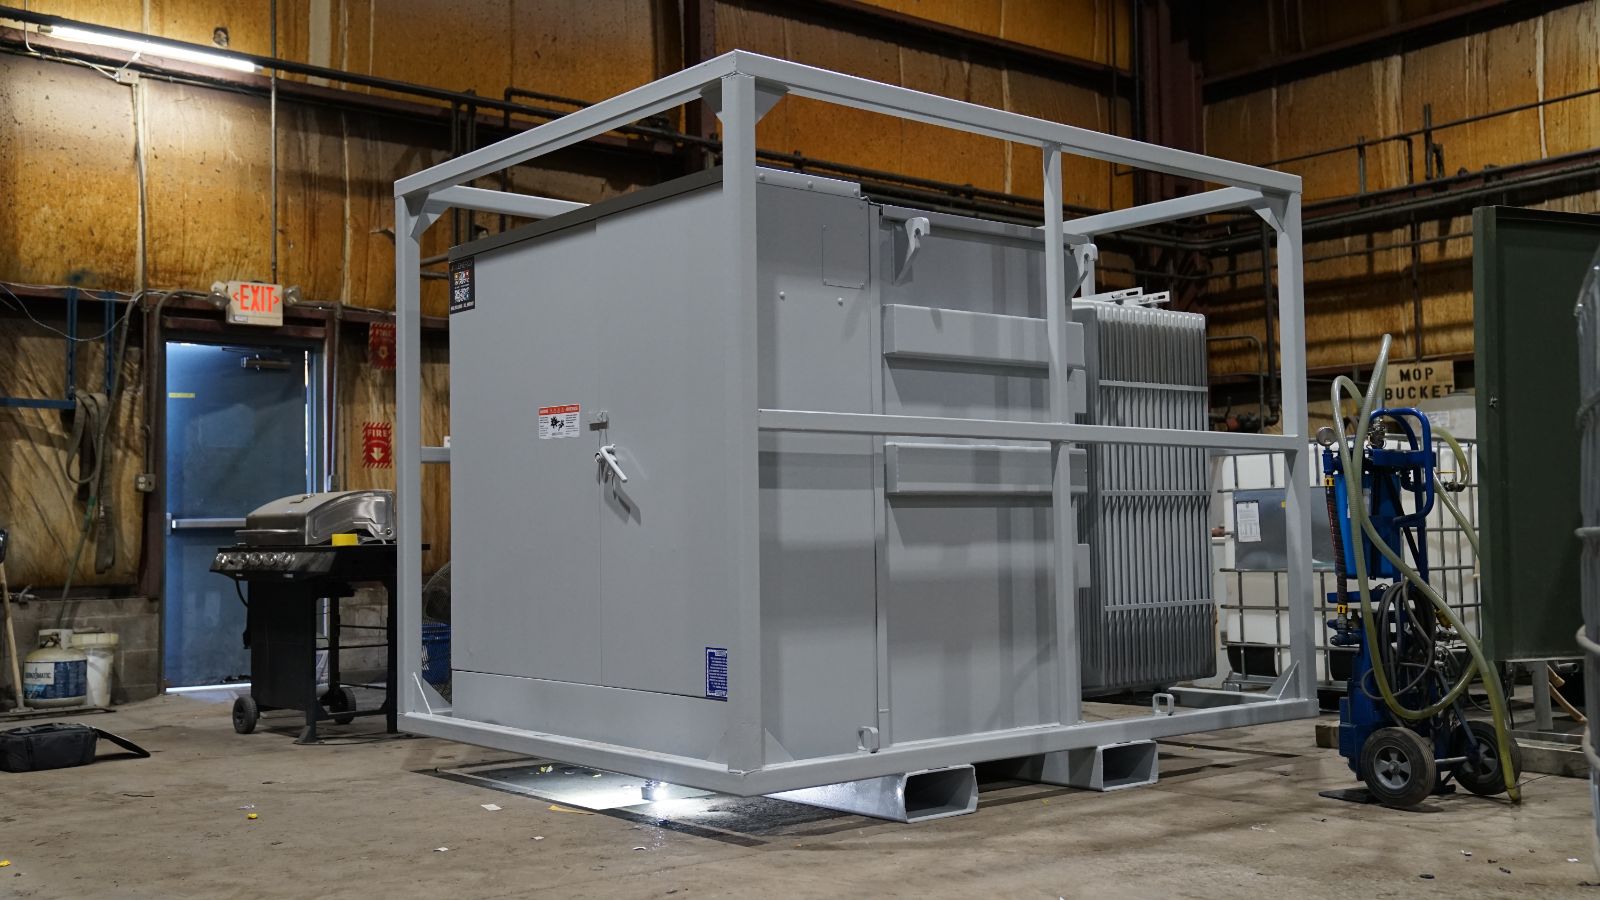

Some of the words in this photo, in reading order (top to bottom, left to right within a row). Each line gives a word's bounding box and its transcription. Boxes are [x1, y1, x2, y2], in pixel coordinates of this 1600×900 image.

[240, 285, 274, 313] EXIT
[1400, 367, 1433, 382] MOP
[1385, 385, 1453, 400] BUCKET
[367, 429, 388, 438] FIRE
